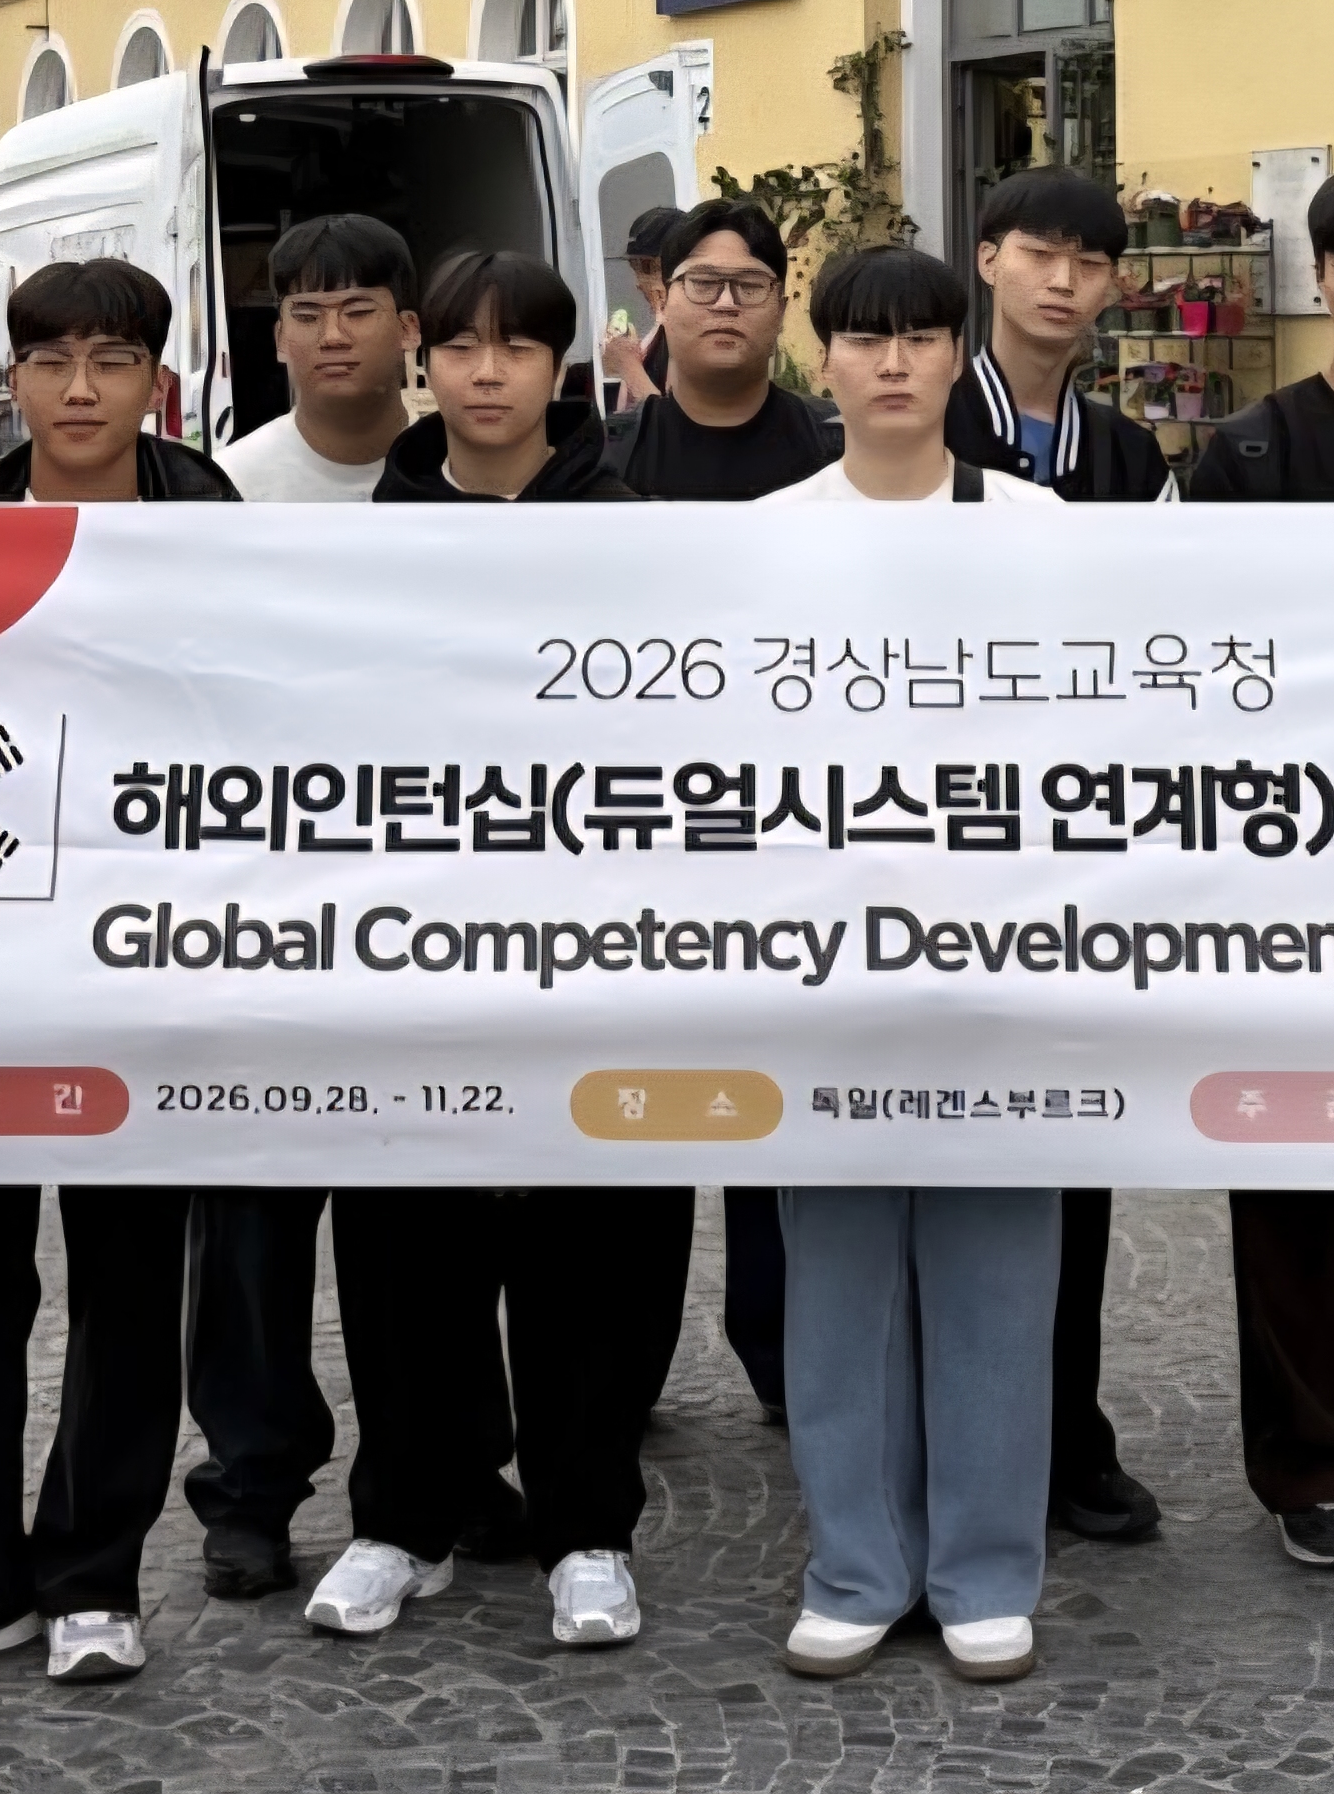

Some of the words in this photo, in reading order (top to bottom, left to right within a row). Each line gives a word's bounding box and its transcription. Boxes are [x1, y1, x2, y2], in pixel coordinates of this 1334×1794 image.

[535, 638, 726, 701] 2026
[753, 633, 1276, 713] 경상남도교육청
[112, 760, 1022, 857] 해외인턴십(듀얼시스템
[92, 901, 337, 972] Global
[354, 905, 848, 990] Competency
